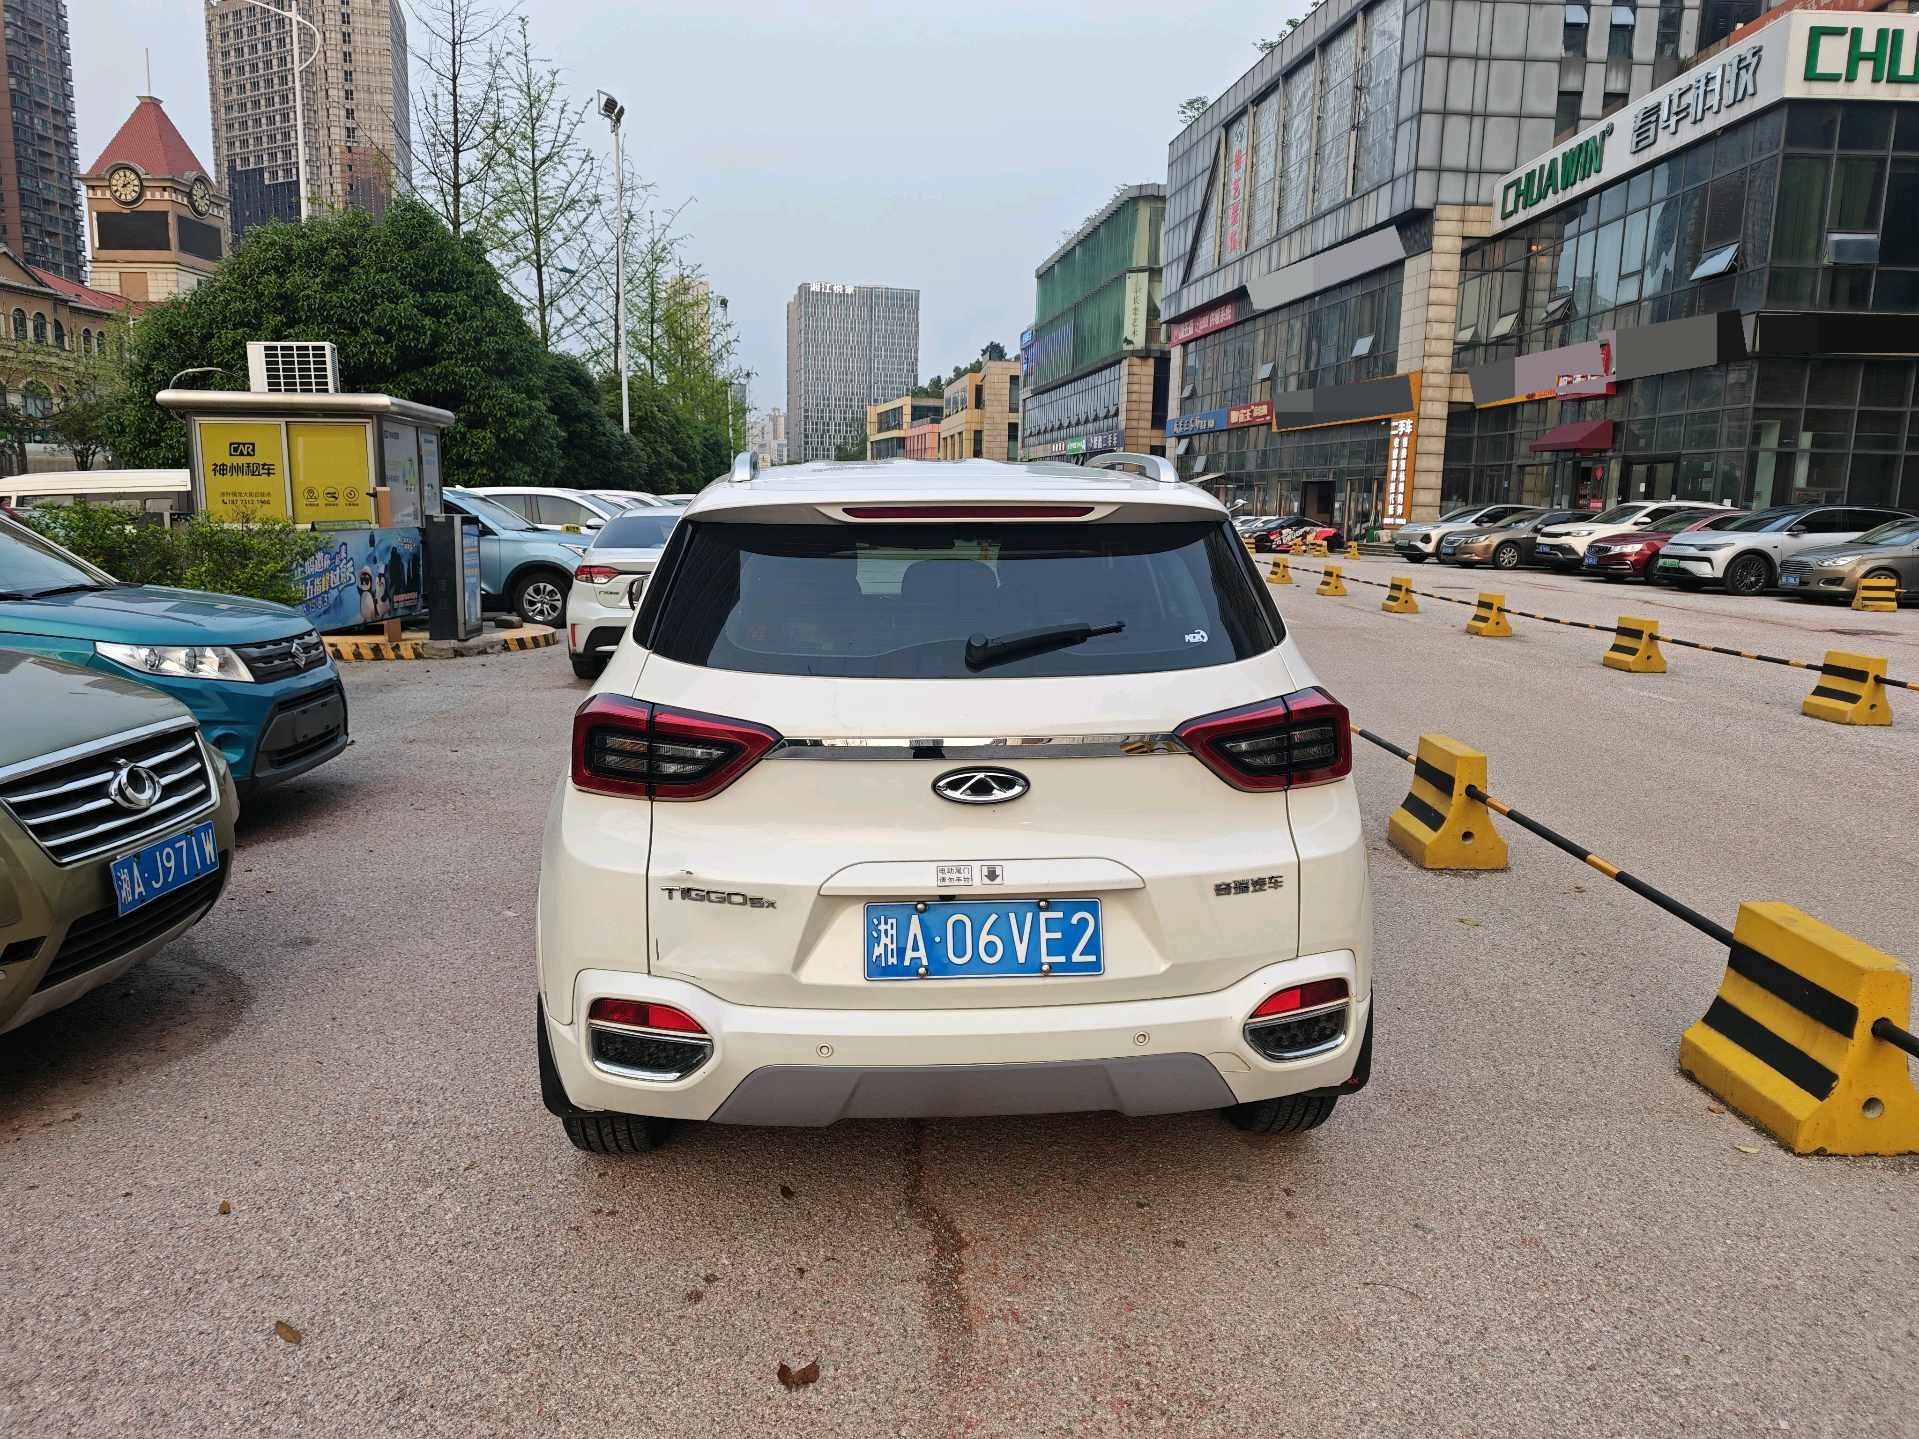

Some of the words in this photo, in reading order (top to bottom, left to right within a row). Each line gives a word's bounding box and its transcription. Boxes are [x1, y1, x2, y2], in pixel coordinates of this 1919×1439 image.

[1630, 44, 1764, 154] 春华科技
[230, 444, 254, 456] CAR
[212, 462, 276, 477] 神州租车
[1214, 875, 1284, 897] 奇瑞汽车
